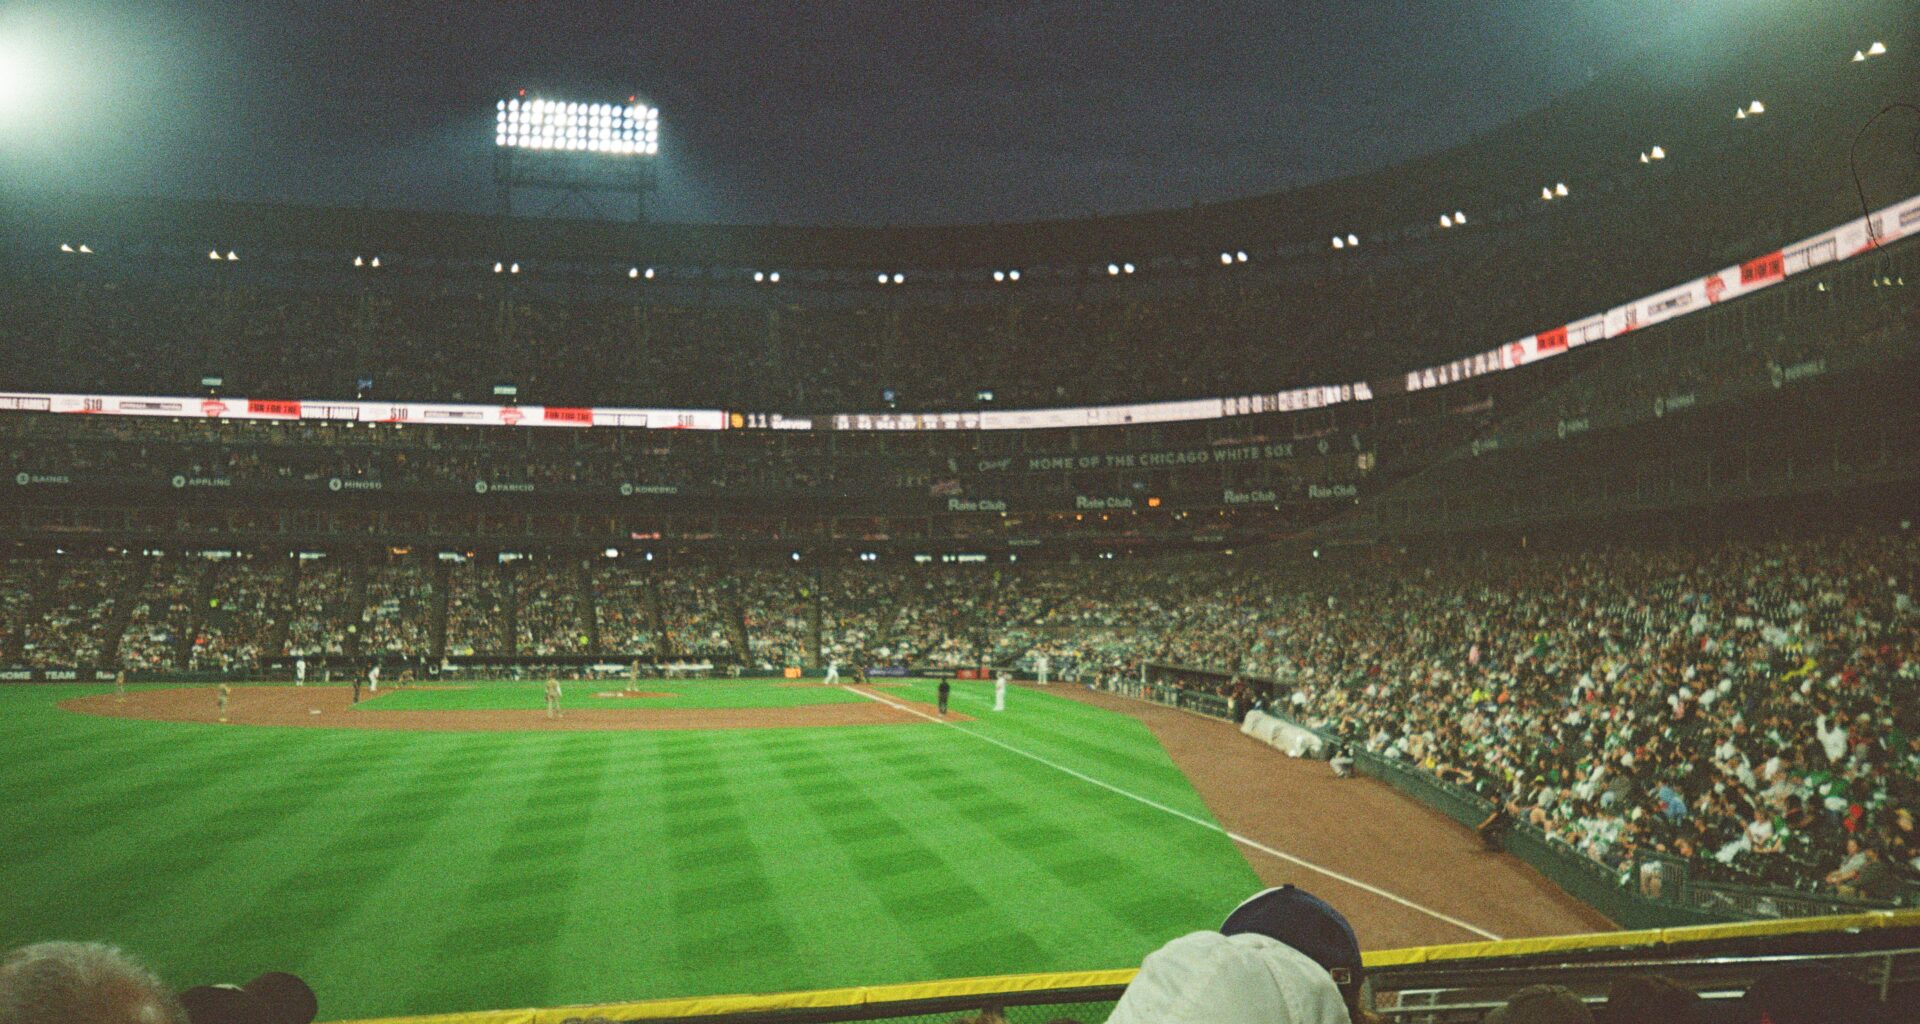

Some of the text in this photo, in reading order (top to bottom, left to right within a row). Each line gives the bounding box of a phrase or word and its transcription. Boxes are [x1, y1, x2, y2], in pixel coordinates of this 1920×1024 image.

[390, 407, 408, 420] $10
[748, 414, 767, 428] 11
[1029, 444, 1294, 469] HOME OF THE CHICAGO WHITE SOX
[188, 477, 231, 486] APPLING
[490, 484, 534, 492] APARICIO
[1333, 484, 1357, 496] Club
[1224, 489, 1276, 503] Rate Club
[979, 500, 1006, 511] Club
[1076, 496, 1133, 509] Rate Club
[45, 671, 76, 680] TEAM
